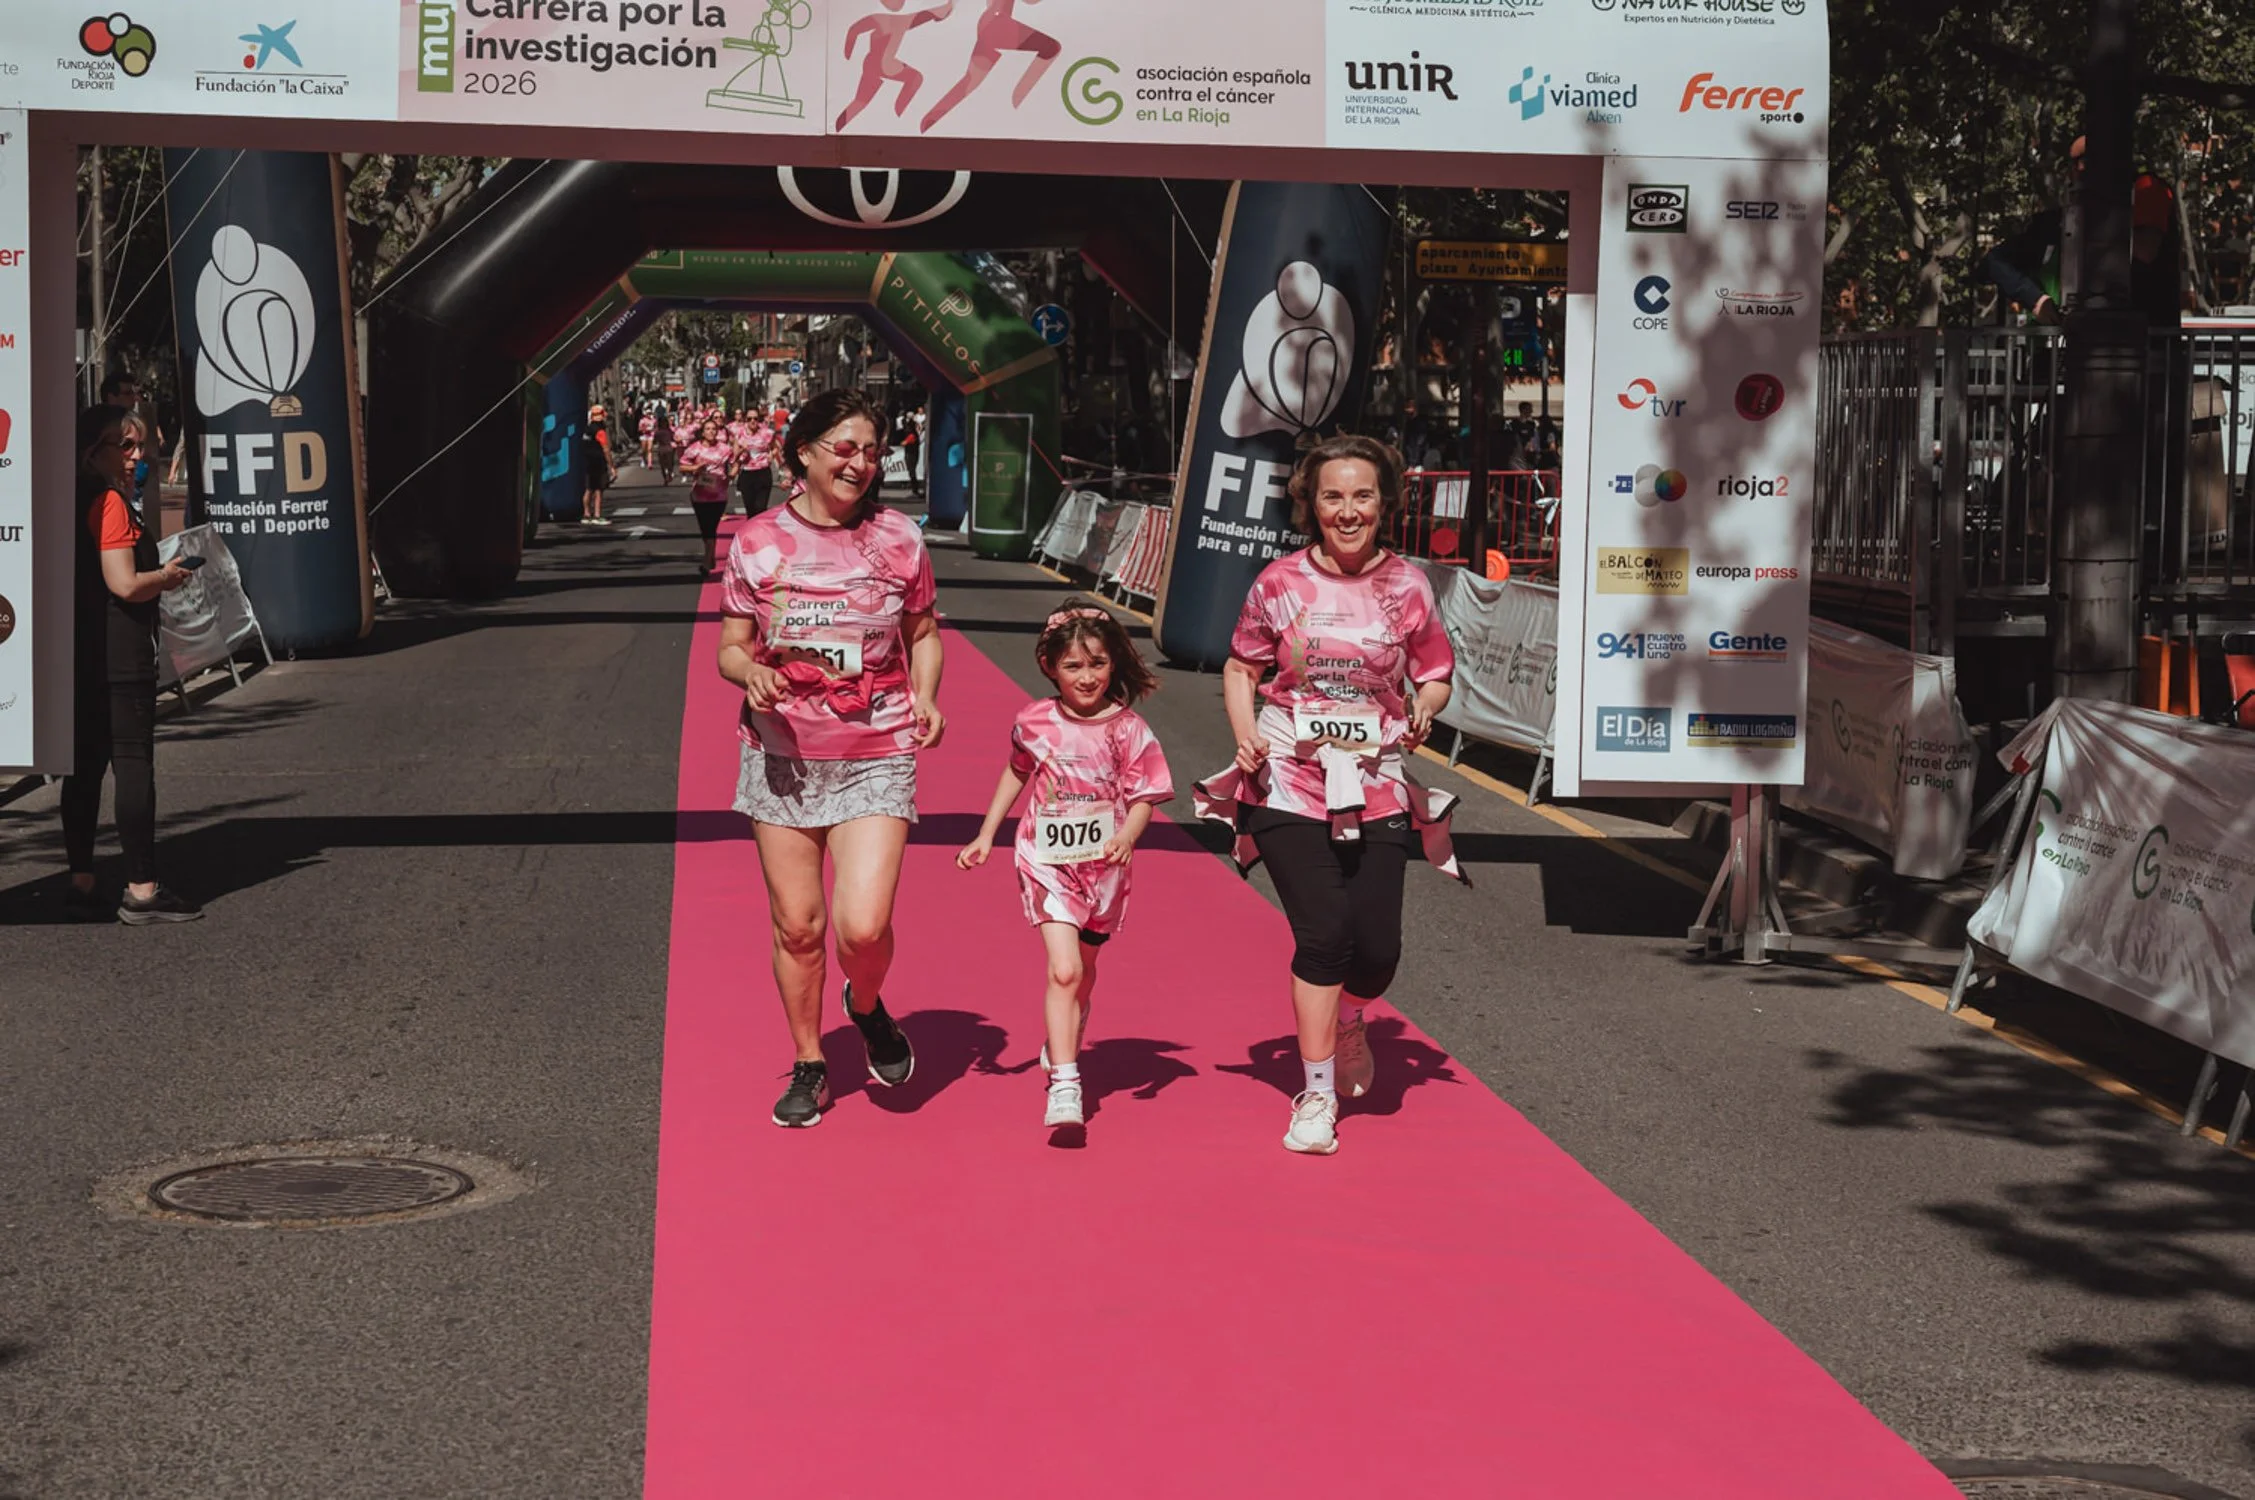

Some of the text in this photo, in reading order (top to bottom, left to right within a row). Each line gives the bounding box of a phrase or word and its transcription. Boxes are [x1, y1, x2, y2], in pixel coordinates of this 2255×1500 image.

[465, 0, 726, 31] Carrera por la
[1370, 5, 1517, 18] CLÍNICA MEDICINA ESTÉTICA
[1624, 14, 1665, 25] Expertos
[1680, 15, 1724, 24] Nutrición
[1726, 17, 1732, 27] y
[1733, 16, 1775, 25] Dietética
[465, 29, 717, 72] investigación
[0, 62, 19, 75] te
[57, 58, 115, 71] FUNDACIÓN
[88, 70, 115, 80] RIOJA
[1136, 66, 1311, 86] asociación española
[1586, 71, 1620, 85] Clínica
[71, 79, 115, 91] DEPORTE
[195, 77, 275, 94] Fundación
[464, 71, 536, 95] 2026
[1136, 87, 1275, 104] contra el cáncer
[1345, 95, 1407, 105] UNIVERSIDAD
[1550, 84, 1637, 108] viamed
[1136, 107, 1230, 127] en La Rioja
[1345, 106, 1421, 116] INTERNACIONAL
[1760, 112, 1792, 124] sport
[1345, 116, 1400, 125] DE LA RIOJA
[1637, 196, 1678, 205] ONDA
[1639, 211, 1677, 222] CERO
[1726, 201, 1779, 219] SER
[1421, 247, 1520, 261] aparcamiento
[1420, 264, 1457, 274] plaza
[1737, 305, 1795, 316] LA RIOJA
[890, 276, 981, 374] PITILLOS
[1633, 318, 1668, 330] COPE
[1651, 396, 1687, 417] tvr
[200, 431, 327, 495] FFD
[1204, 451, 1292, 520] FF
[1718, 476, 1789, 500] rioja2
[205, 499, 329, 516] Fundación Ferrer
[209, 516, 329, 536] ara el Deporte
[1201, 515, 1277, 543] Fundación
[0, 526, 24, 541] UT
[1198, 535, 1231, 553] para
[1238, 542, 1254, 557] el
[1646, 569, 1683, 581] MATEO
[1696, 566, 1798, 581] europa press
[787, 598, 846, 610] Carrera
[785, 614, 830, 626] por la
[1305, 637, 1321, 650] XI
[1597, 632, 1684, 659] 941 nueve
[1647, 642, 1687, 651] cuatro
[1709, 631, 1787, 650] Gente
[1306, 655, 1361, 668] Carrera
[1647, 651, 1671, 659] uno
[1332, 671, 1345, 682] la
[1310, 720, 1368, 742] 9075
[1602, 713, 1666, 738] El Día
[1720, 723, 1748, 736] RADIO
[1931, 758, 1942, 770] el
[1925, 773, 1954, 792] Rioja
[1046, 820, 1102, 848] 9076
[2042, 848, 2060, 865] en
[2061, 852, 2074, 869] La
